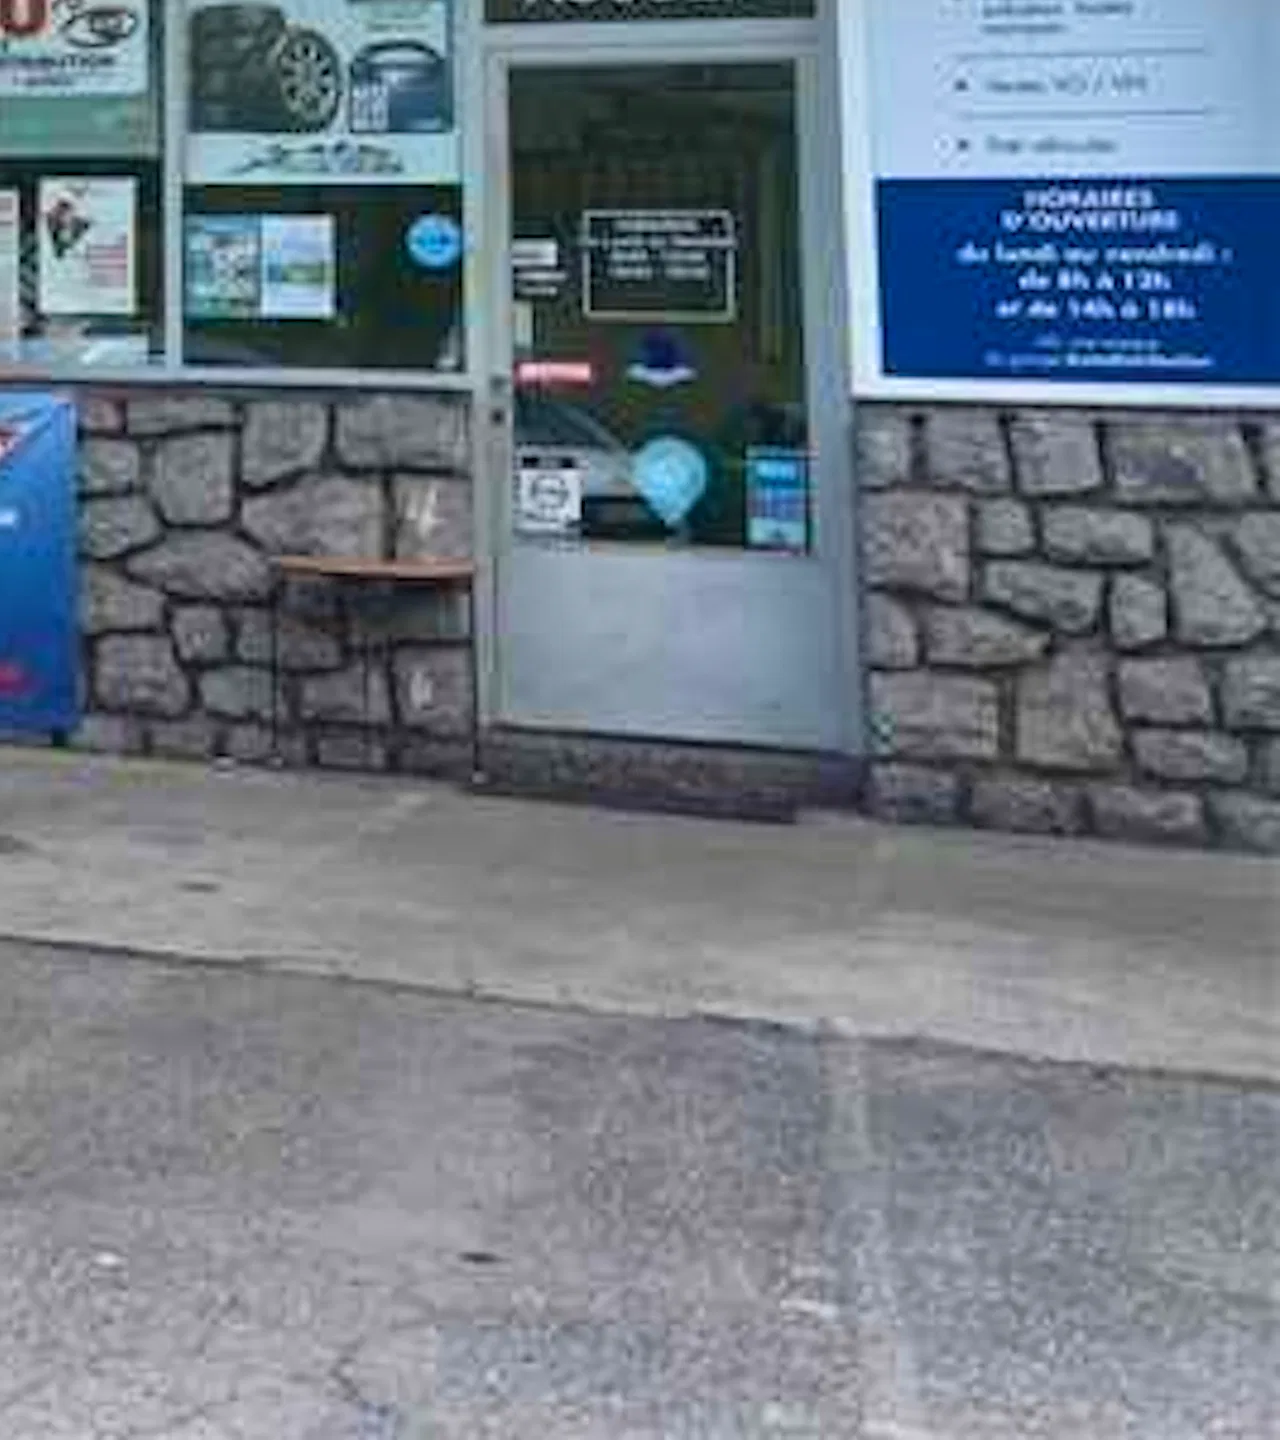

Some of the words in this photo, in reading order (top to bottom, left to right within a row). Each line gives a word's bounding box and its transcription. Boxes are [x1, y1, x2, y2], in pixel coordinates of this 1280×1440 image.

[1022, 188, 1154, 209] HORAIRES
[1000, 210, 1179, 232] D'OUVERTURE
[1018, 267, 1051, 290] de
